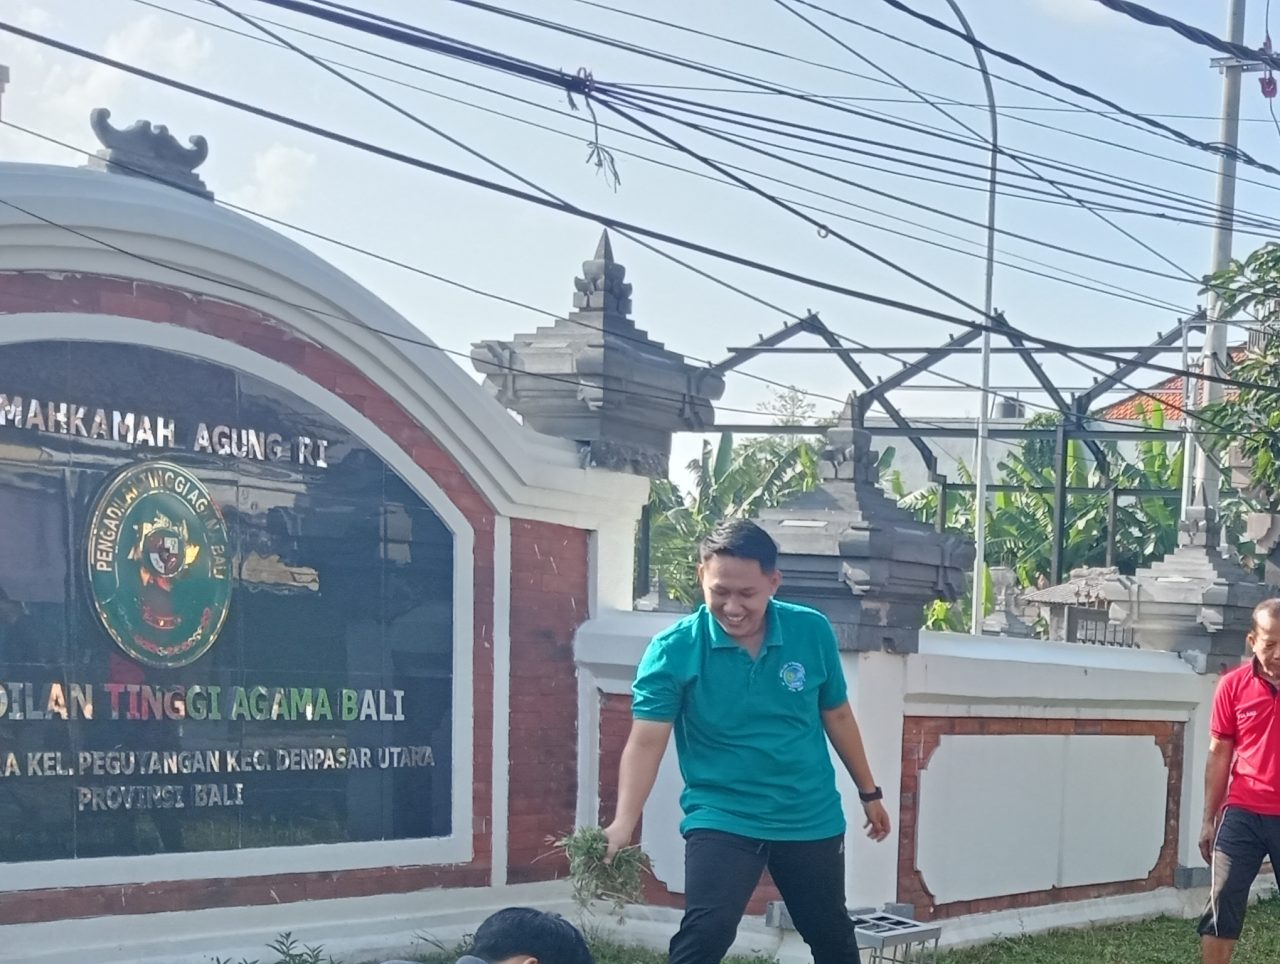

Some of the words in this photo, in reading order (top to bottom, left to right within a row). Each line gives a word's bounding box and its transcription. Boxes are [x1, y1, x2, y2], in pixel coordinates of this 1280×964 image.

[0, 394, 175, 448] MAHKAMAH
[194, 423, 290, 462] AGUNG
[298, 436, 328, 469] RI
[104, 684, 221, 720] TINGGI
[231, 686, 333, 721] AGAMA
[341, 688, 405, 721] BALI
[27, 751, 74, 776] KEL.
[226, 748, 272, 772] KEC.
[276, 747, 372, 771] DENPASAR
[378, 746, 436, 768] UTARA
[77, 784, 185, 811] PROVINSI
[193, 783, 244, 807] BALI
